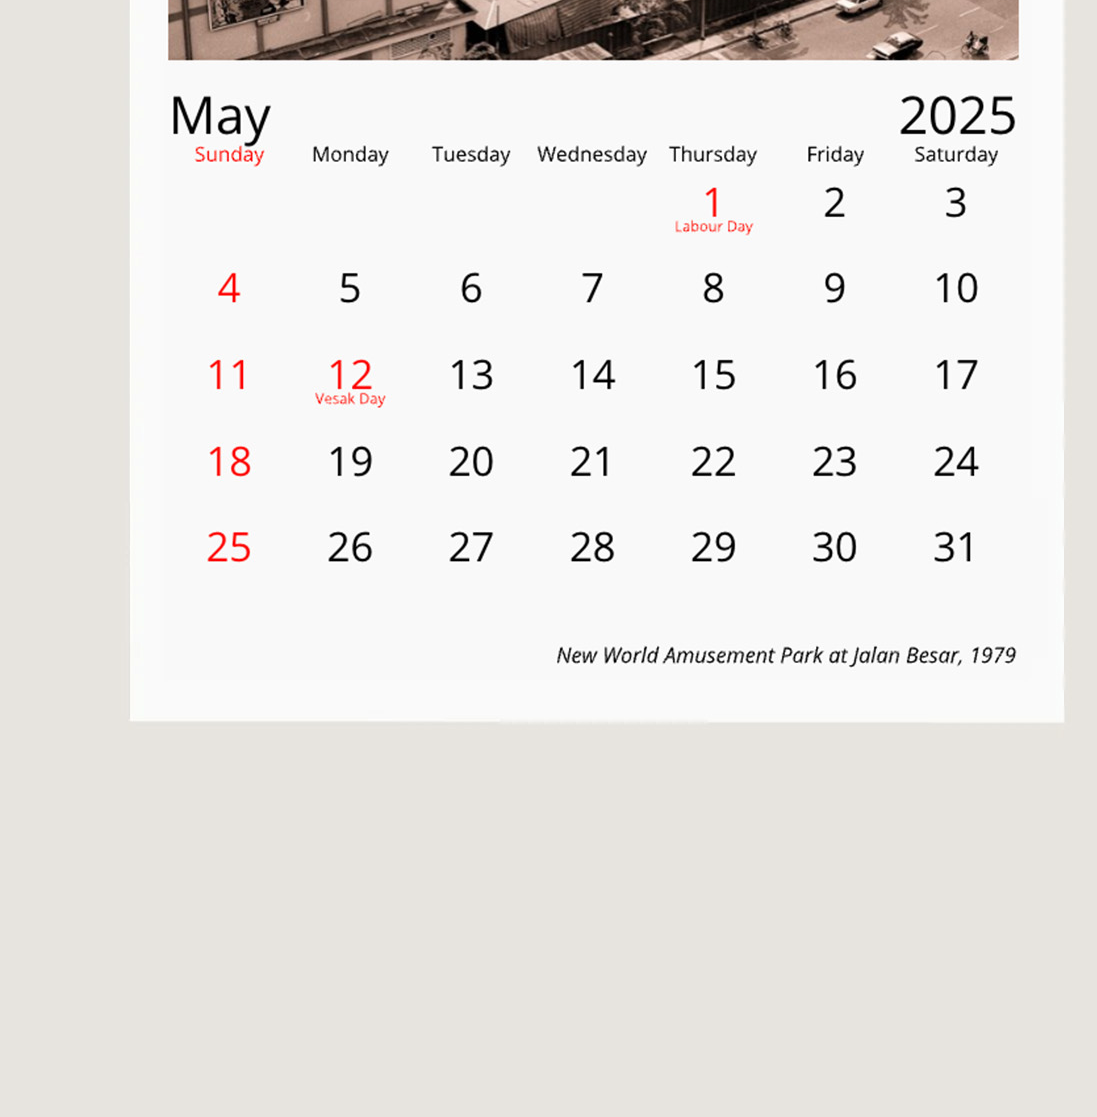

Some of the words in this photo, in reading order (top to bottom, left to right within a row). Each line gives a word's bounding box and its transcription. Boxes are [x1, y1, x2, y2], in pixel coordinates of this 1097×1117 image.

[173, 96, 271, 148] May
[900, 96, 1015, 135] 2025
[195, 146, 264, 167] Sunday
[313, 146, 389, 167] Monday
[432, 146, 510, 167] Tuesday
[537, 146, 647, 167] Wednesday
[669, 146, 757, 167] Thursday
[808, 146, 864, 167] Friday
[915, 146, 998, 167] Saturday
[706, 187, 717, 217] 1
[825, 187, 845, 217] 2
[946, 187, 966, 218] 3
[676, 219, 724, 232] Labour
[728, 220, 753, 235] Day
[218, 273, 240, 303] 4
[340, 273, 360, 303] 5
[462, 272, 481, 303] 6
[582, 273, 603, 303] 7
[704, 272, 723, 303] 8
[825, 272, 845, 303] 9
[937, 272, 978, 303] 10
[210, 360, 244, 389] 11
[331, 359, 372, 389] 12
[452, 359, 492, 390] 13
[573, 360, 615, 389] 14
[694, 360, 735, 390] 15
[816, 359, 856, 390] 16
[937, 360, 978, 389] 17
[315, 392, 356, 405] Vesak
[360, 393, 386, 408] Day
[210, 446, 250, 477] 18
[331, 446, 372, 477] 19
[450, 446, 493, 477] 20
[571, 446, 607, 476] 21
[692, 446, 735, 476] 22
[813, 446, 856, 477] 23
[934, 446, 979, 476] 24
[208, 532, 250, 562] 25
[328, 532, 372, 562] 26
[450, 532, 493, 562] 27
[571, 532, 614, 562] 28
[692, 532, 735, 562] 29
[813, 532, 856, 562] 30
[934, 532, 971, 562] 31
[557, 647, 598, 663] New
[604, 646, 659, 663] World
[663, 647, 776, 663] Amusement
[781, 646, 824, 663] Park
[829, 646, 848, 663] at
[850, 646, 900, 667] Jalan
[907, 647, 962, 666] Besar,
[972, 647, 1016, 663] 1979
